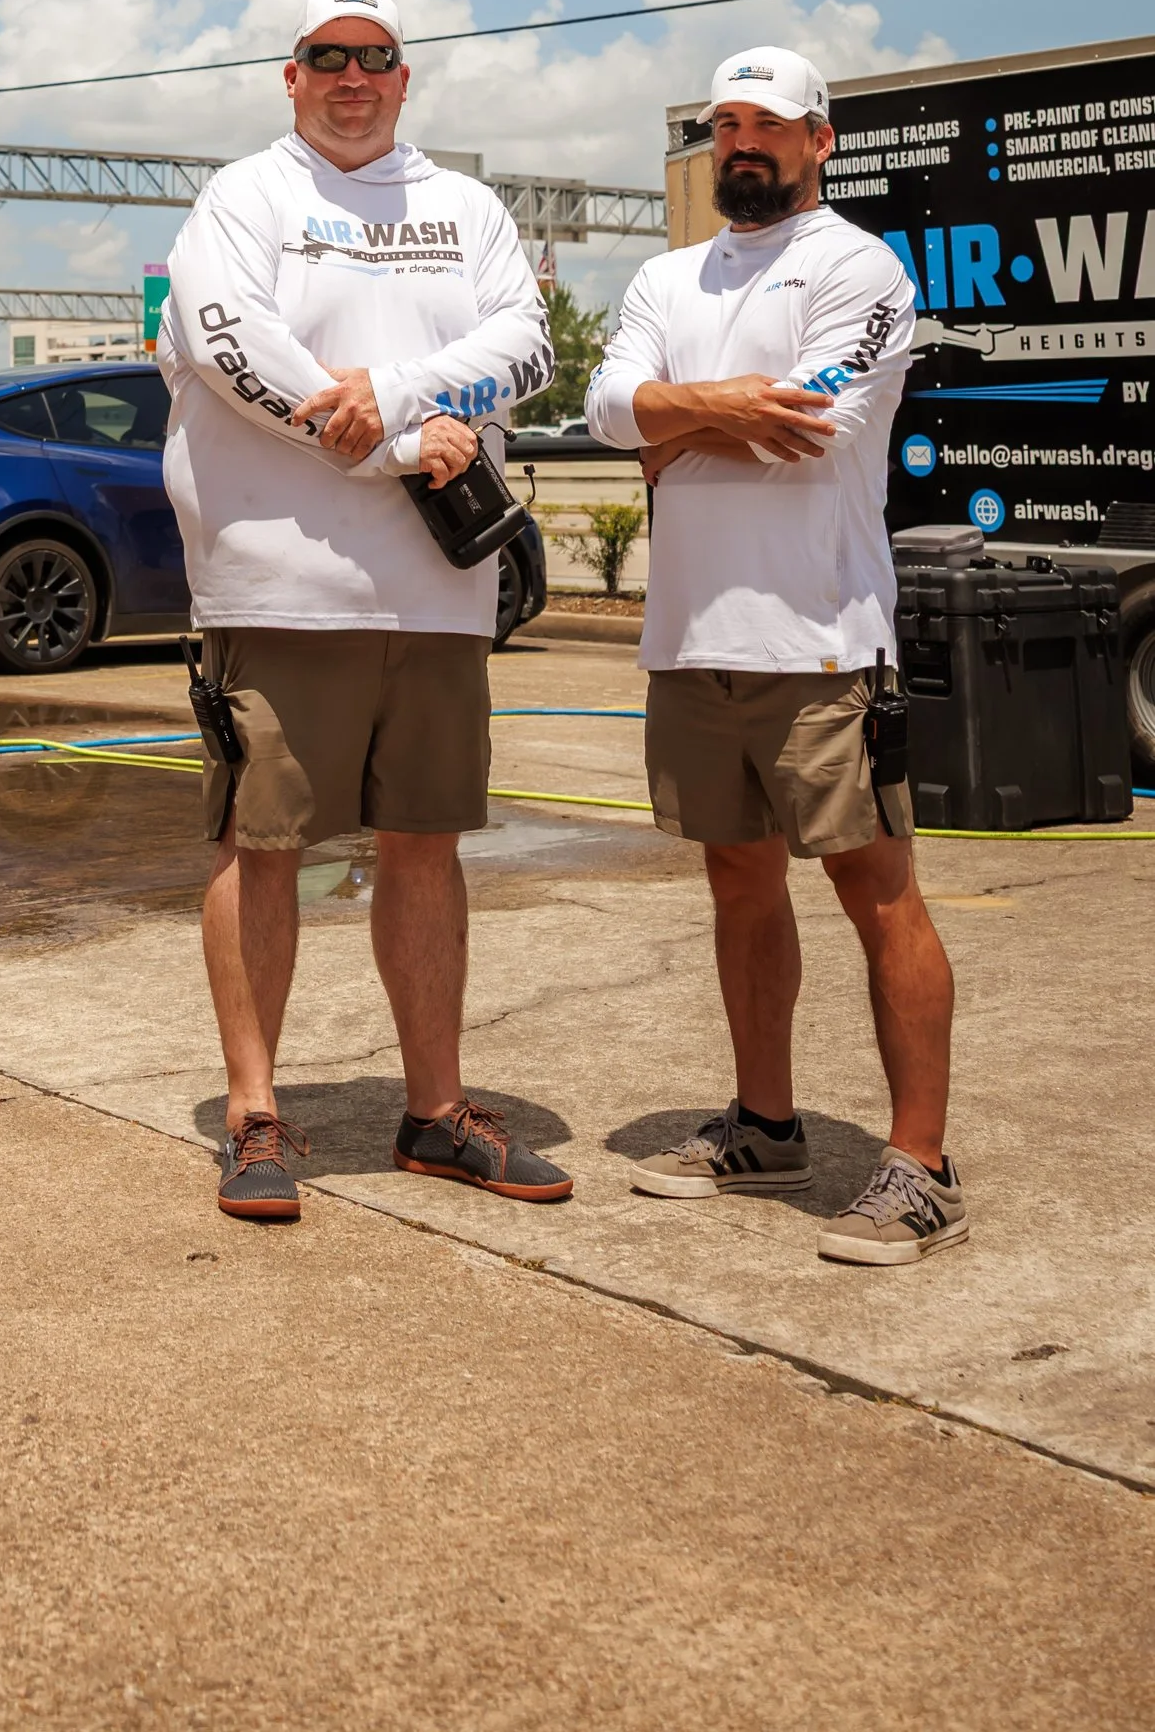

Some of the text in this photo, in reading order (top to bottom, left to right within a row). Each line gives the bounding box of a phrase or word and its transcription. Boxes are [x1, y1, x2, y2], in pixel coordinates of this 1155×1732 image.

[1004, 105, 1081, 131] PRE-PAINT
[1085, 102, 1106, 121] OR
[839, 127, 899, 151] BUILDING
[1006, 134, 1057, 156] SMART
[1060, 129, 1099, 150] ROOF
[825, 146, 950, 176] WINDOW CLEANING
[1007, 155, 1111, 181] COMMERCIAL,
[827, 177, 889, 200] CLEANING
[411, 252, 462, 261] CLEANING
[1020, 331, 1146, 351] HEIGHTS
[1122, 381, 1150, 403] BY
[942, 444, 1155, 471] hello@airwash.drag
[1014, 499, 1111, 521] airwash.
